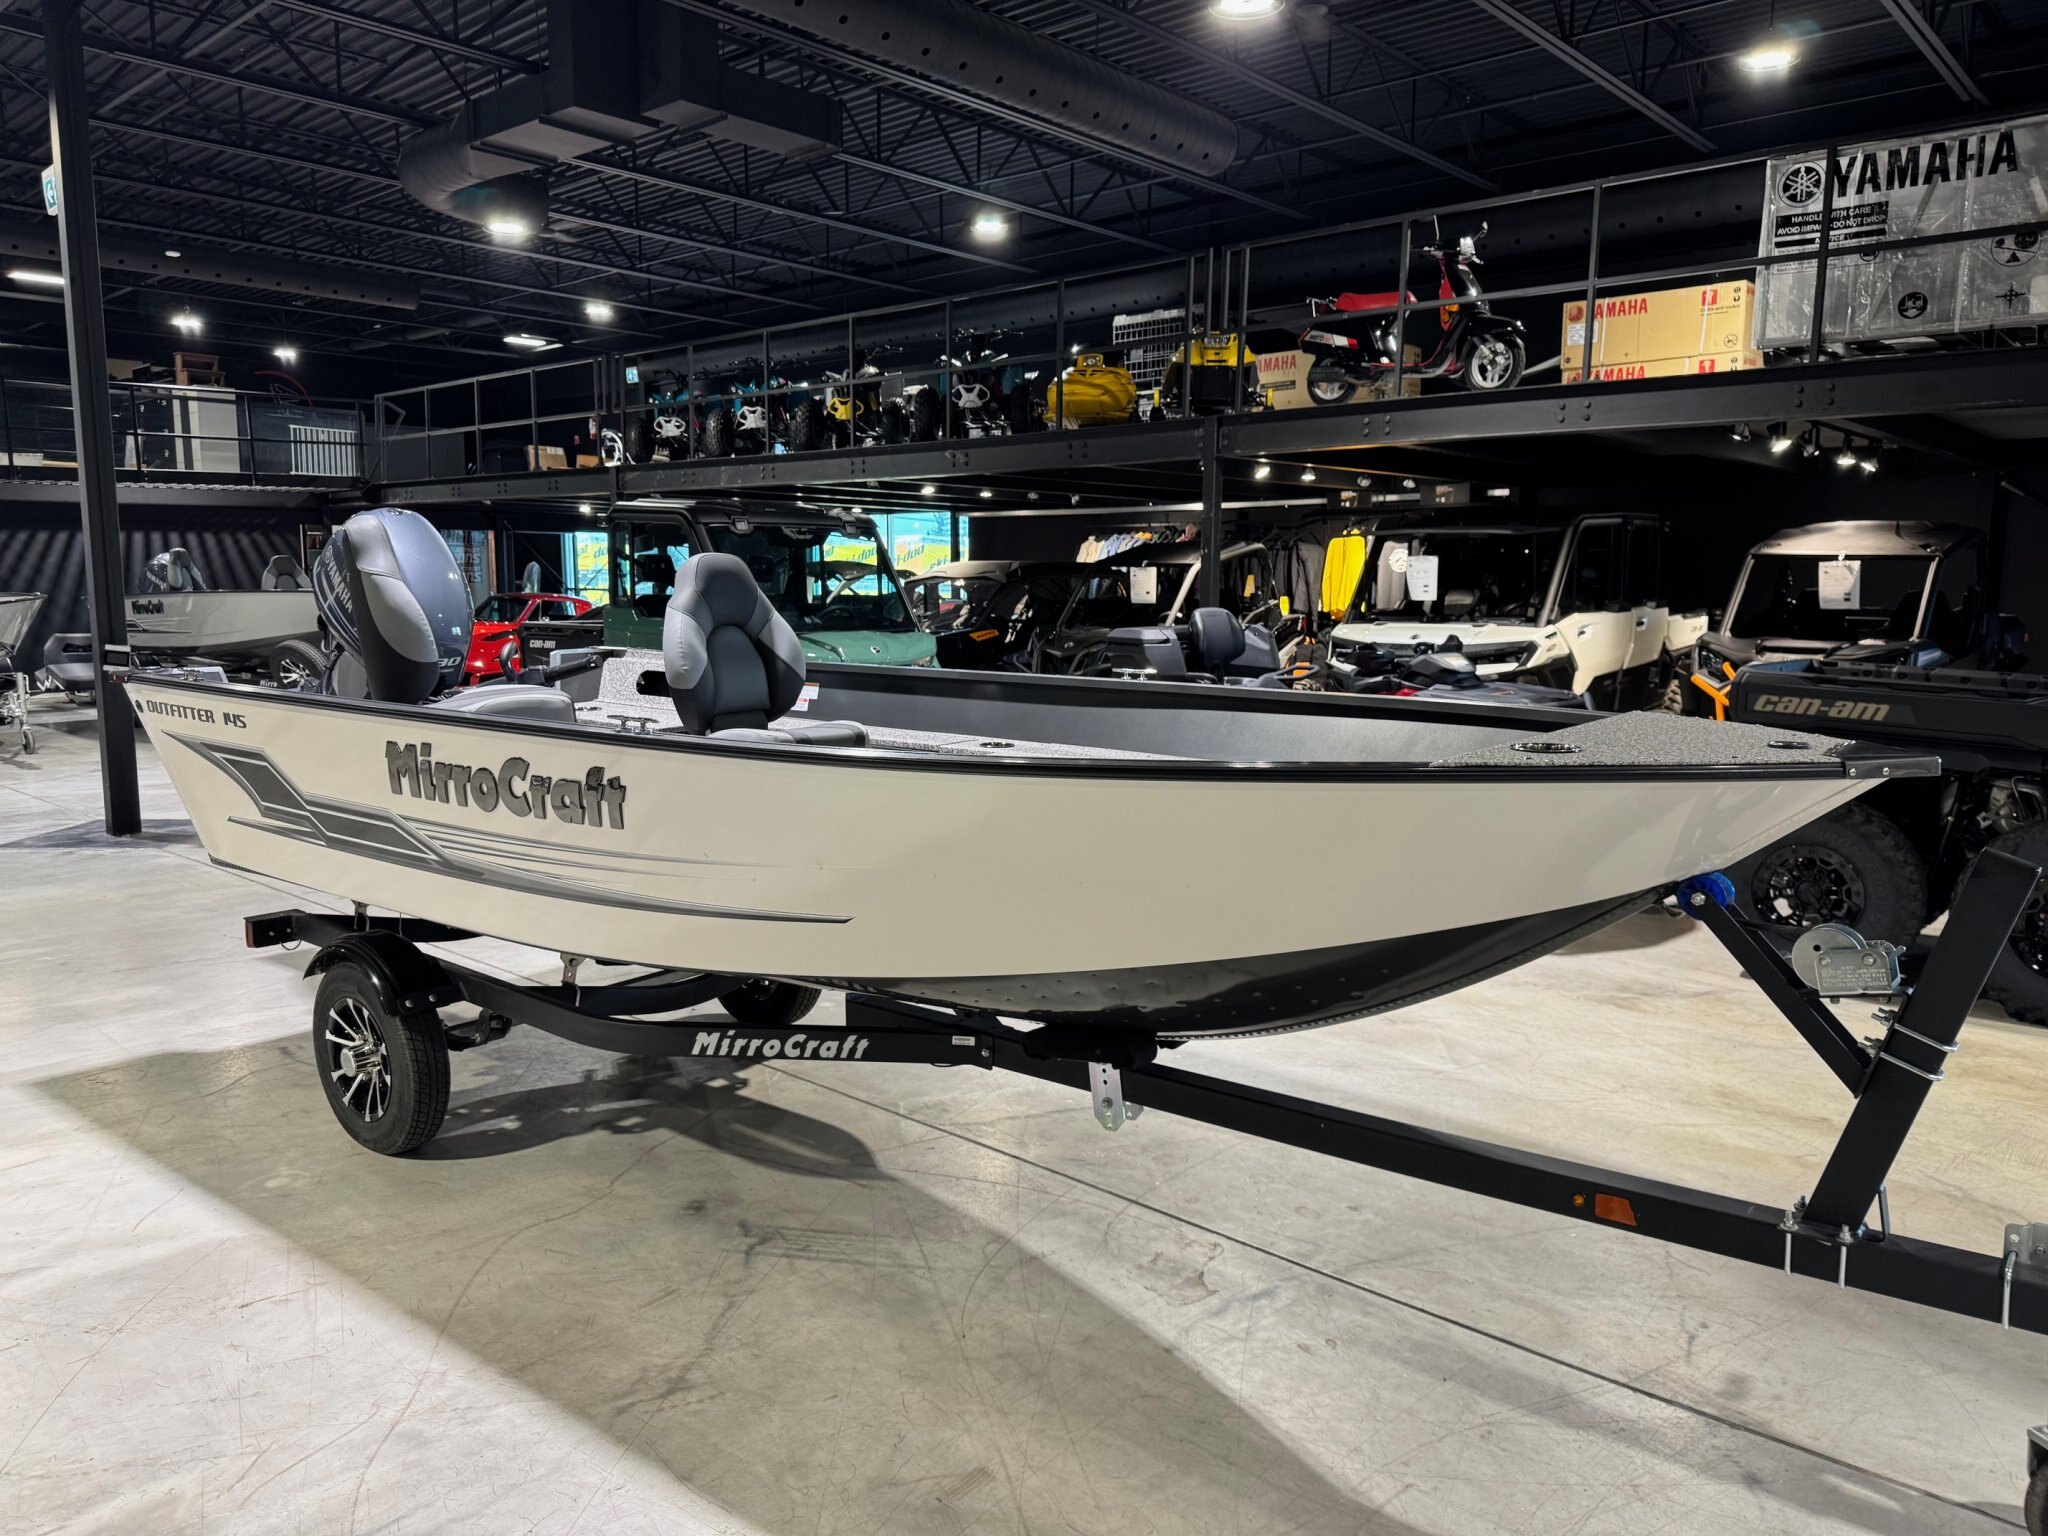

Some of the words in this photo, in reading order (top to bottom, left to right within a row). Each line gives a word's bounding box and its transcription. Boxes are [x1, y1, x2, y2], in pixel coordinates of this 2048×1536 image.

[1835, 130, 2018, 197] YAMAHA
[1776, 226, 1800, 235] AVOID
[1801, 224, 1821, 232] IMPA
[1846, 217, 1862, 226] NOT
[1863, 215, 1886, 224] DROP
[1849, 207, 1871, 216] CARE
[1595, 298, 1648, 319] AMAHA
[328, 556, 353, 613] YAMAHA
[146, 700, 215, 723] OUTFITTER
[223, 712, 247, 728] 145
[1753, 694, 1890, 722] can-am
[385, 740, 626, 829] MirroCraft
[691, 1029, 870, 1059] MirroCraft
